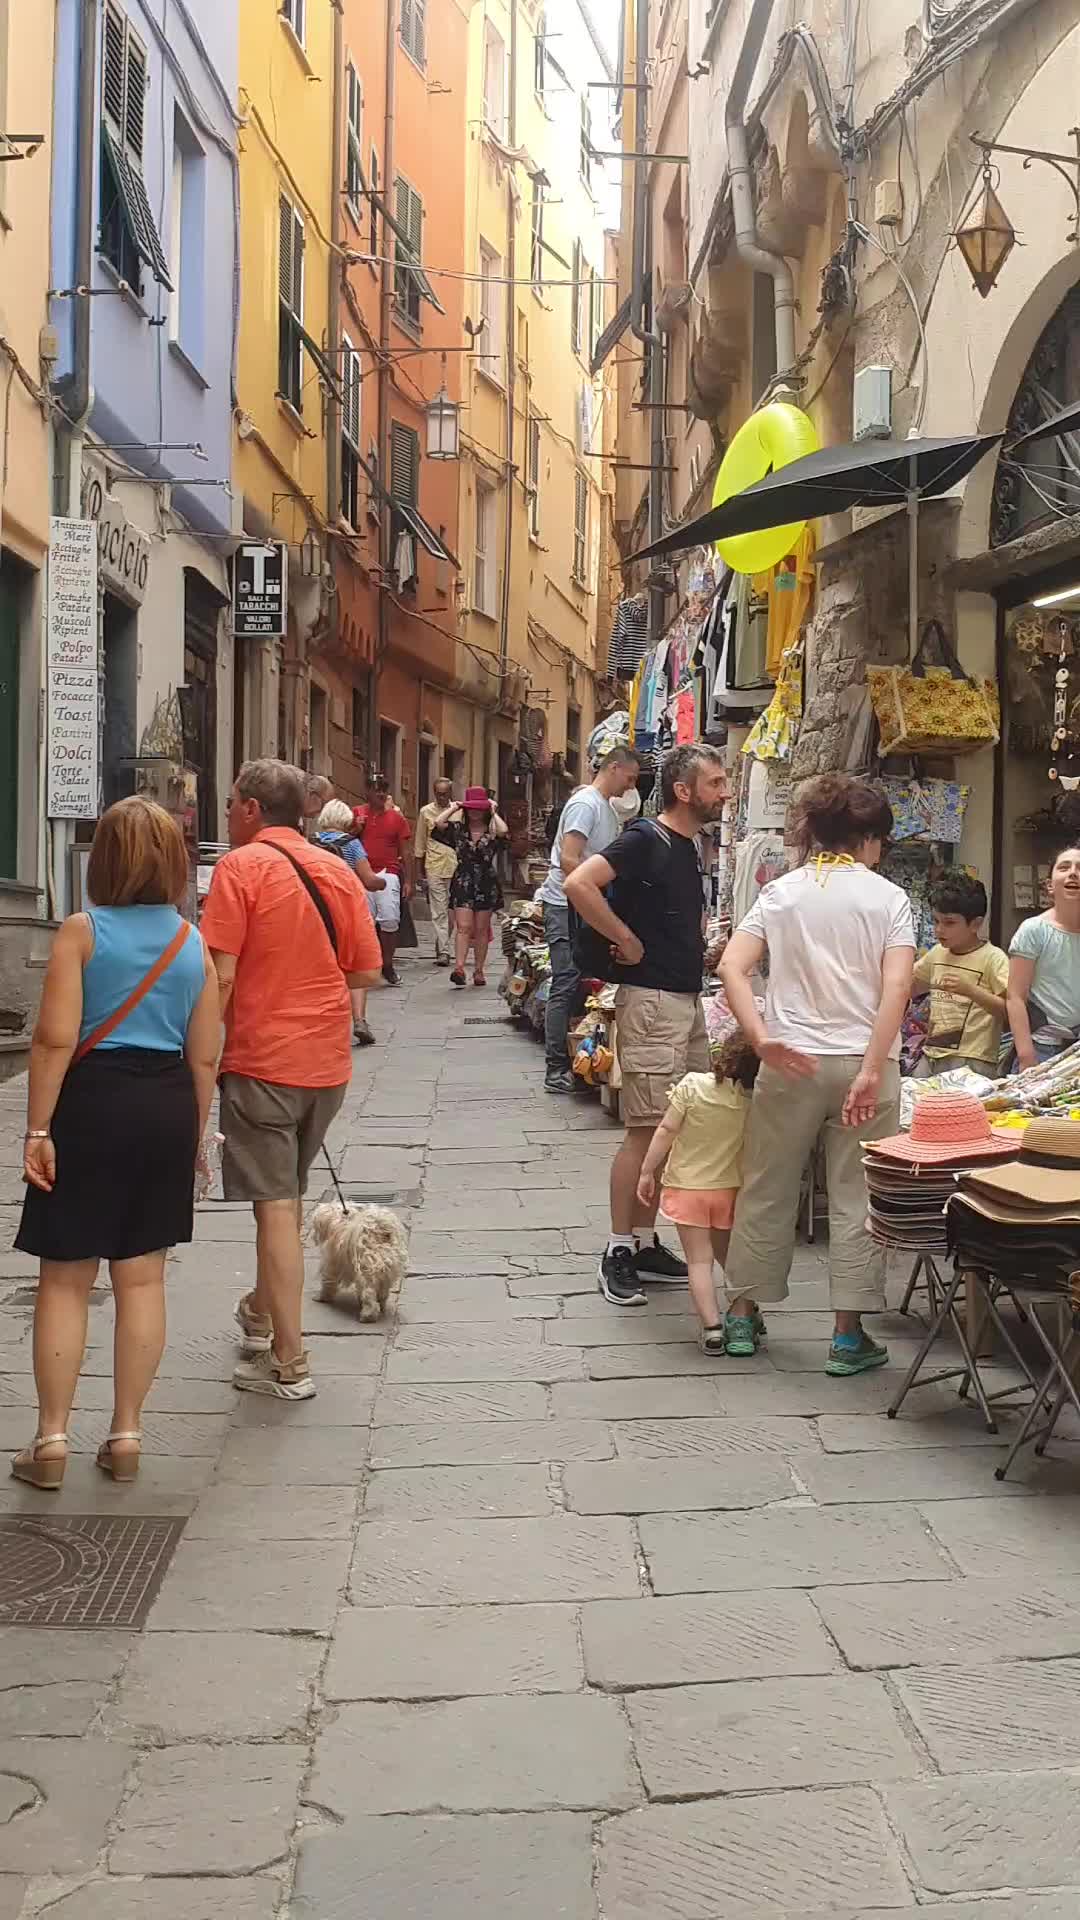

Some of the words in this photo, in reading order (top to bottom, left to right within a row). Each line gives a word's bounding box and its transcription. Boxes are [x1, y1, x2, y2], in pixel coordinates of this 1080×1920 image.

[52, 520, 92, 531] Antipasti
[64, 530, 91, 542] Mare
[52, 542, 92, 554] Acciughe
[51, 551, 81, 563] Fritte
[243, 547, 276, 594] T
[52, 592, 92, 604] Acciughe
[57, 603, 91, 613] Patate
[239, 602, 279, 611] TABACCHI
[51, 616, 92, 627] Muscoli
[246, 615, 272, 623] VALORI
[52, 625, 88, 638] Ripieni
[60, 640, 93, 656] Polpo
[51, 653, 84, 664] Patate
[52, 672, 94, 687] Pizza
[51, 690, 94, 702] Focacce
[53, 707, 93, 721] Toast
[51, 726, 92, 739] Panini
[52, 745, 92, 761] Dolci
[51, 764, 83, 777] Torte
[59, 775, 90, 786] Salate
[53, 790, 90, 803] Salumi
